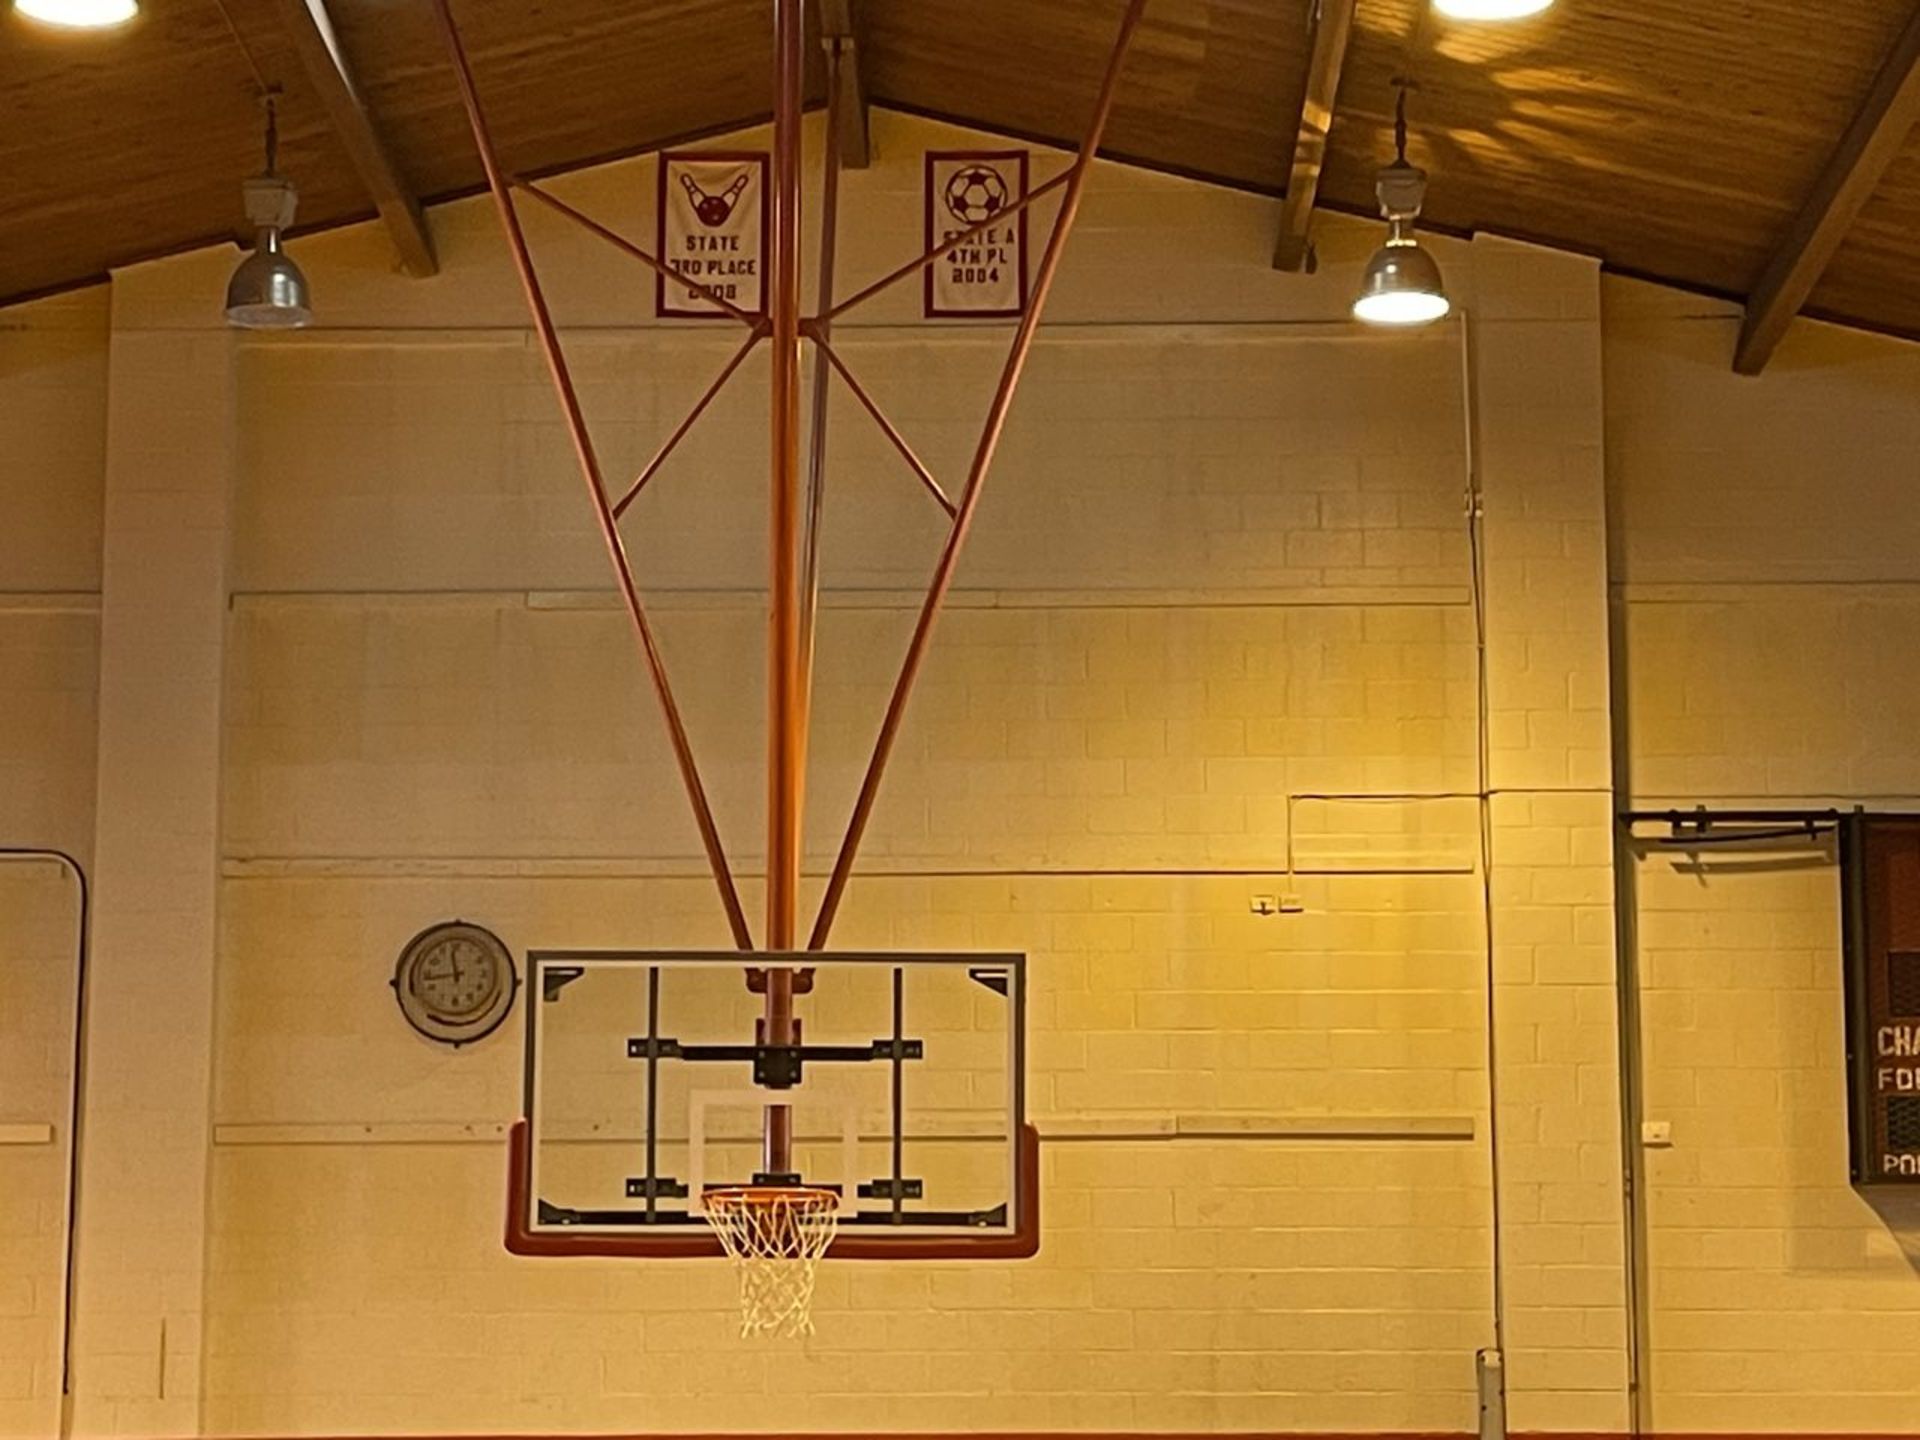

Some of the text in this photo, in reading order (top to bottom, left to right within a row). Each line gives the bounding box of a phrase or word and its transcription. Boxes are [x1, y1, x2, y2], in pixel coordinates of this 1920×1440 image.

[686, 234, 739, 251] STATE
[1005, 227, 1015, 245] A
[946, 247, 1008, 266] 4TH PL
[707, 259, 756, 275] PLACE
[952, 267, 998, 283] 2004
[1878, 1067, 1920, 1091] FO
